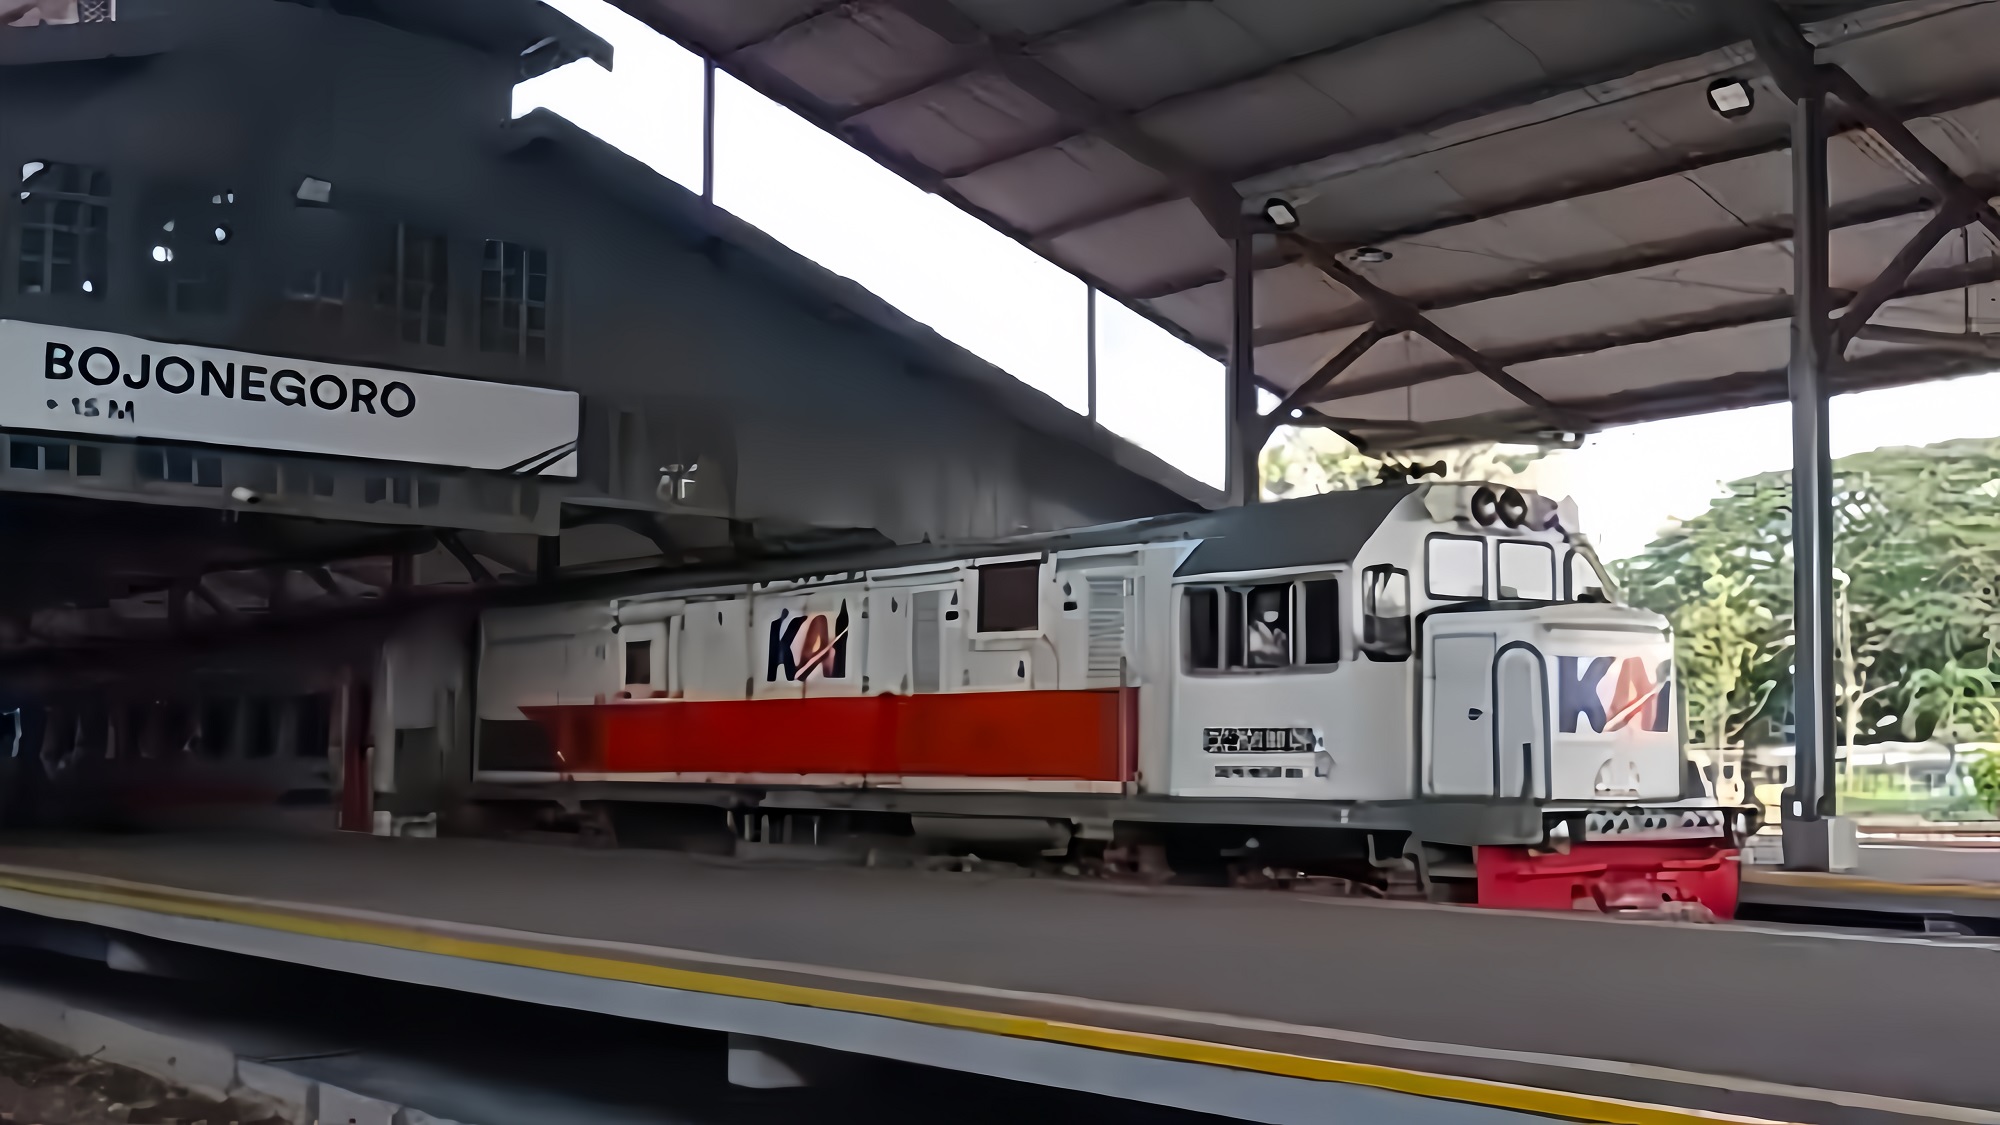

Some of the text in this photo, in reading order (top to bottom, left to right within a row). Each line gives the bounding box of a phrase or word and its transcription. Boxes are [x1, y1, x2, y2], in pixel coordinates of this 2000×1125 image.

[44, 341, 416, 417] BOJONEGORO
[767, 598, 849, 682] KAI
[1559, 656, 1671, 733] KAI
